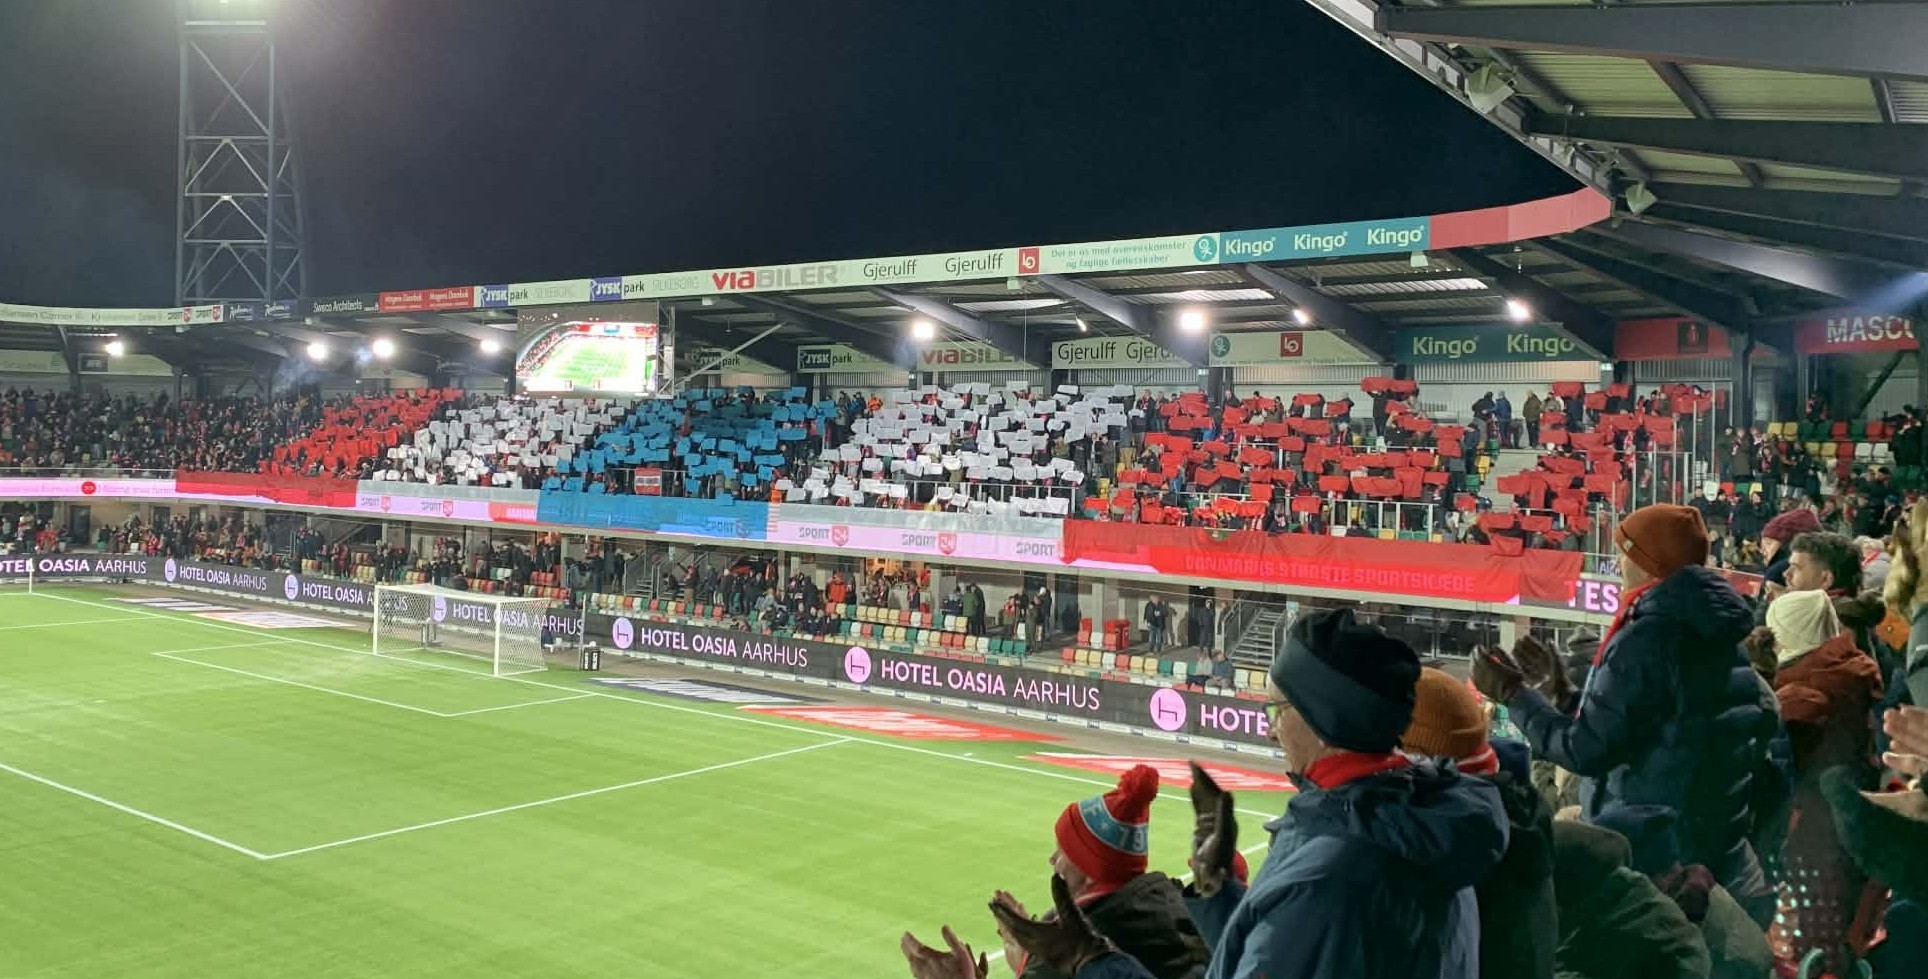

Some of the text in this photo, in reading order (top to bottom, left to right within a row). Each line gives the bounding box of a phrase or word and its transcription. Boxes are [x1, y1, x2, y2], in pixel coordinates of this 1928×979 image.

[1225, 236, 1275, 256] Kingo
[1294, 232, 1347, 251] Kingo
[1367, 226, 1424, 246] Kingo
[863, 258, 917, 279] Gjerulff
[945, 253, 1003, 276] Gjerulff
[509, 287, 529, 302] park
[623, 280, 645, 298] park
[1058, 341, 1116, 364] Gjerulff
[1413, 336, 1477, 358] Kingo
[1507, 333, 1574, 355] Kingo
[832, 352, 853, 367] park
[799, 526, 830, 539] SPORT
[902, 533, 936, 547] SPORT
[1016, 541, 1055, 556] SPORT
[39, 558, 90, 573] OASIA
[95, 559, 147, 574] AARHUS
[180, 565, 267, 591] HOTEL OASIA AARHUS
[302, 582, 334, 601] HOTEL
[335, 587, 363, 604] OASIA
[1564, 579, 1621, 614] TES
[453, 603, 585, 636] HOTEL OASIA AARHUS
[641, 627, 808, 668] HOTEL OASIA AARHUS
[881, 659, 1100, 711] HOTEL OASIA AARHUS
[1200, 703, 1270, 737] HOTE
